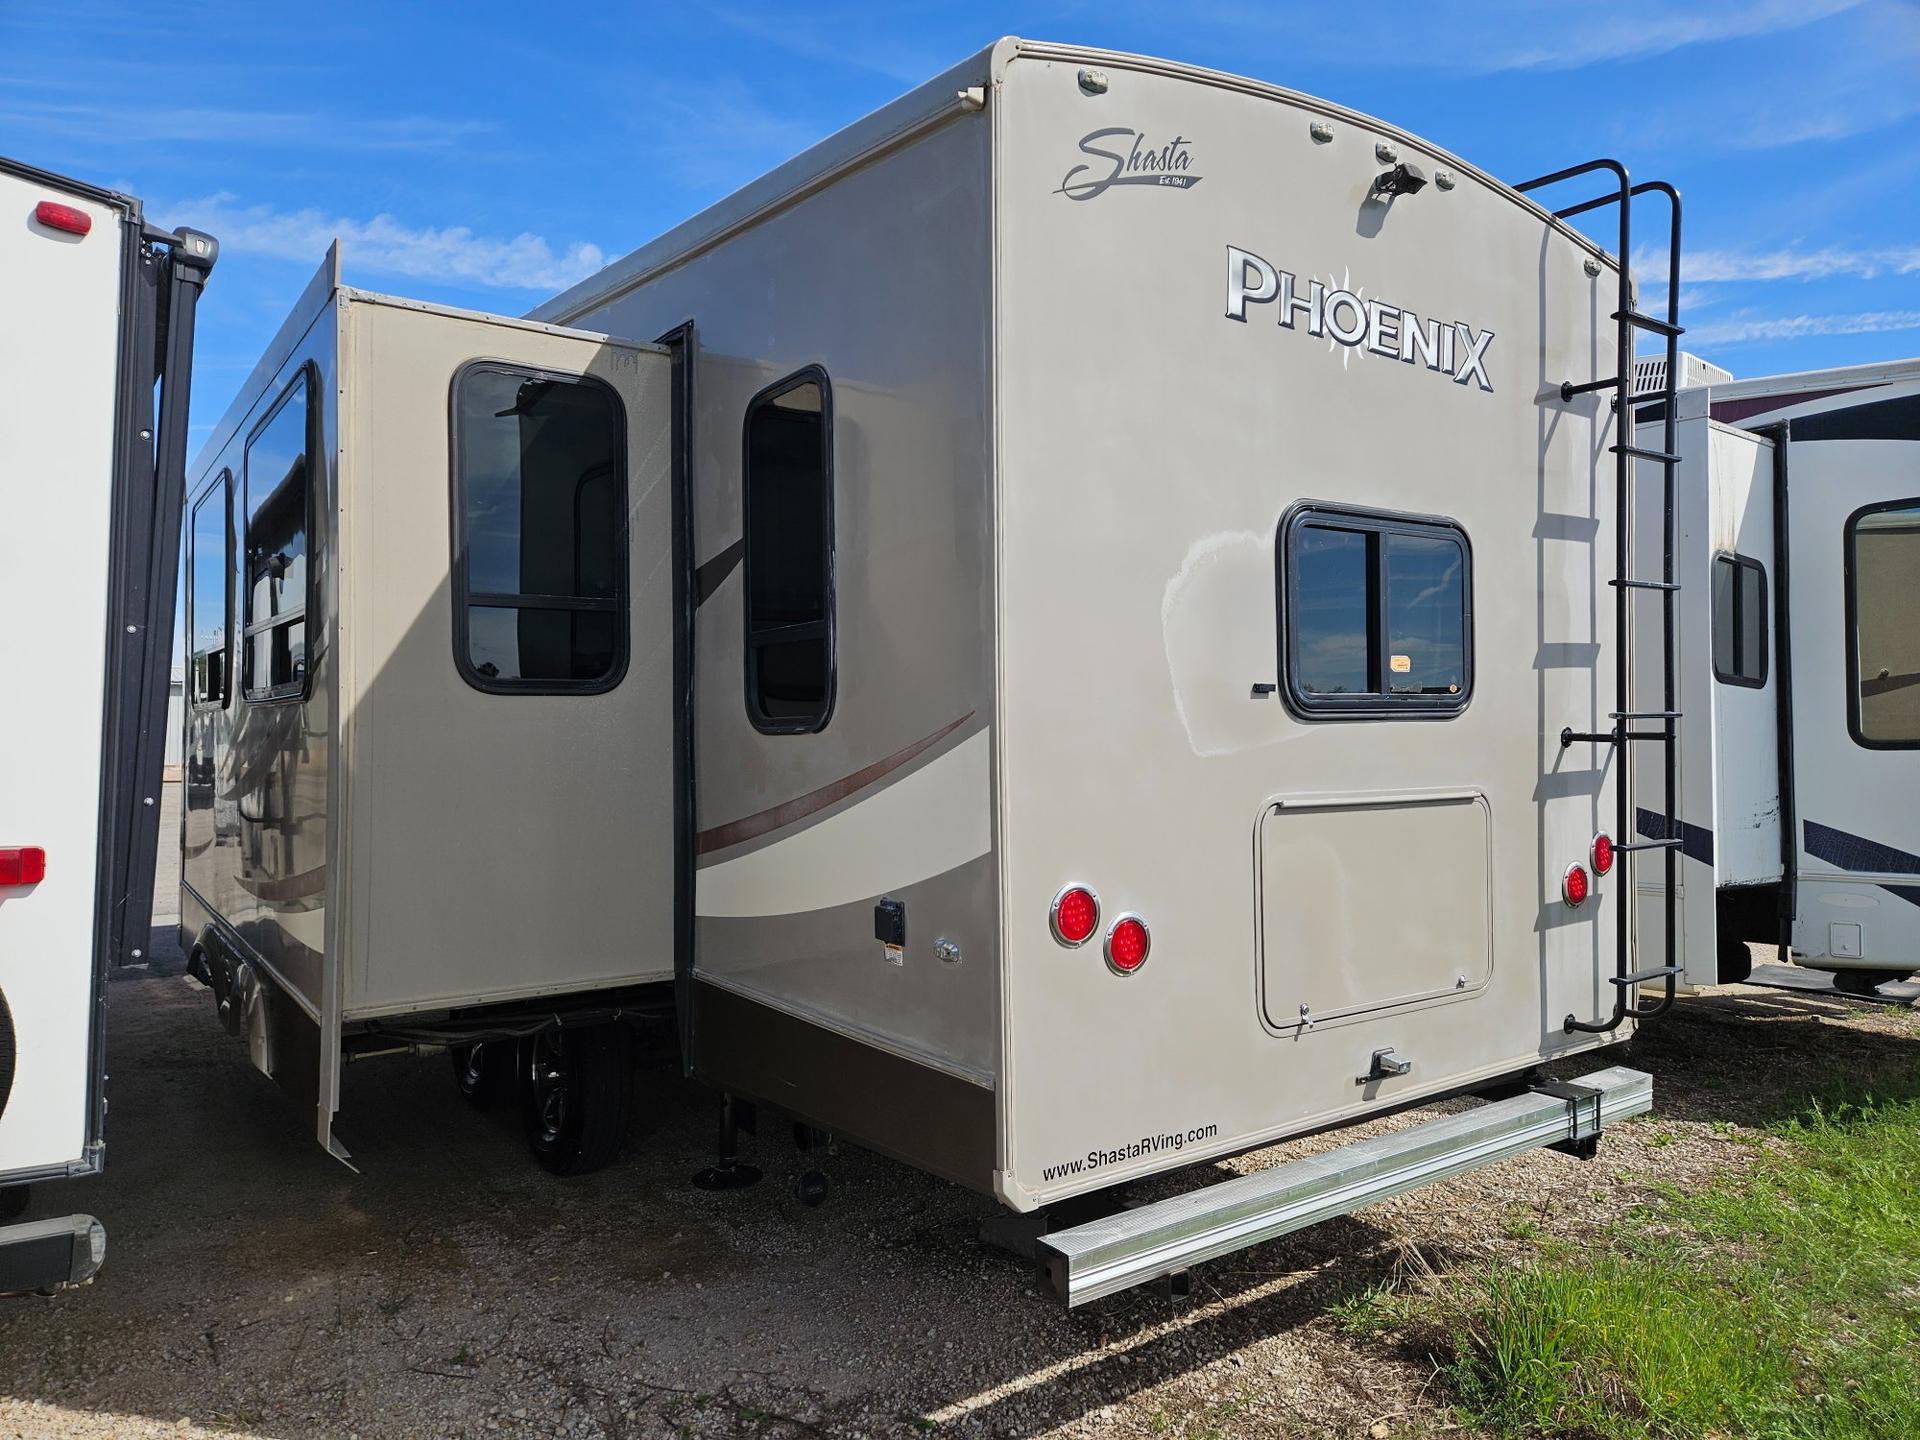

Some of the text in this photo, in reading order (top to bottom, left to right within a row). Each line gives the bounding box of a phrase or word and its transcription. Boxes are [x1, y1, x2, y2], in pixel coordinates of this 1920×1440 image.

[1057, 127, 1194, 201] Shasta
[1225, 244, 1495, 393] PHOENIX
[1042, 1124, 1218, 1182] www.ShastaRVing.com
